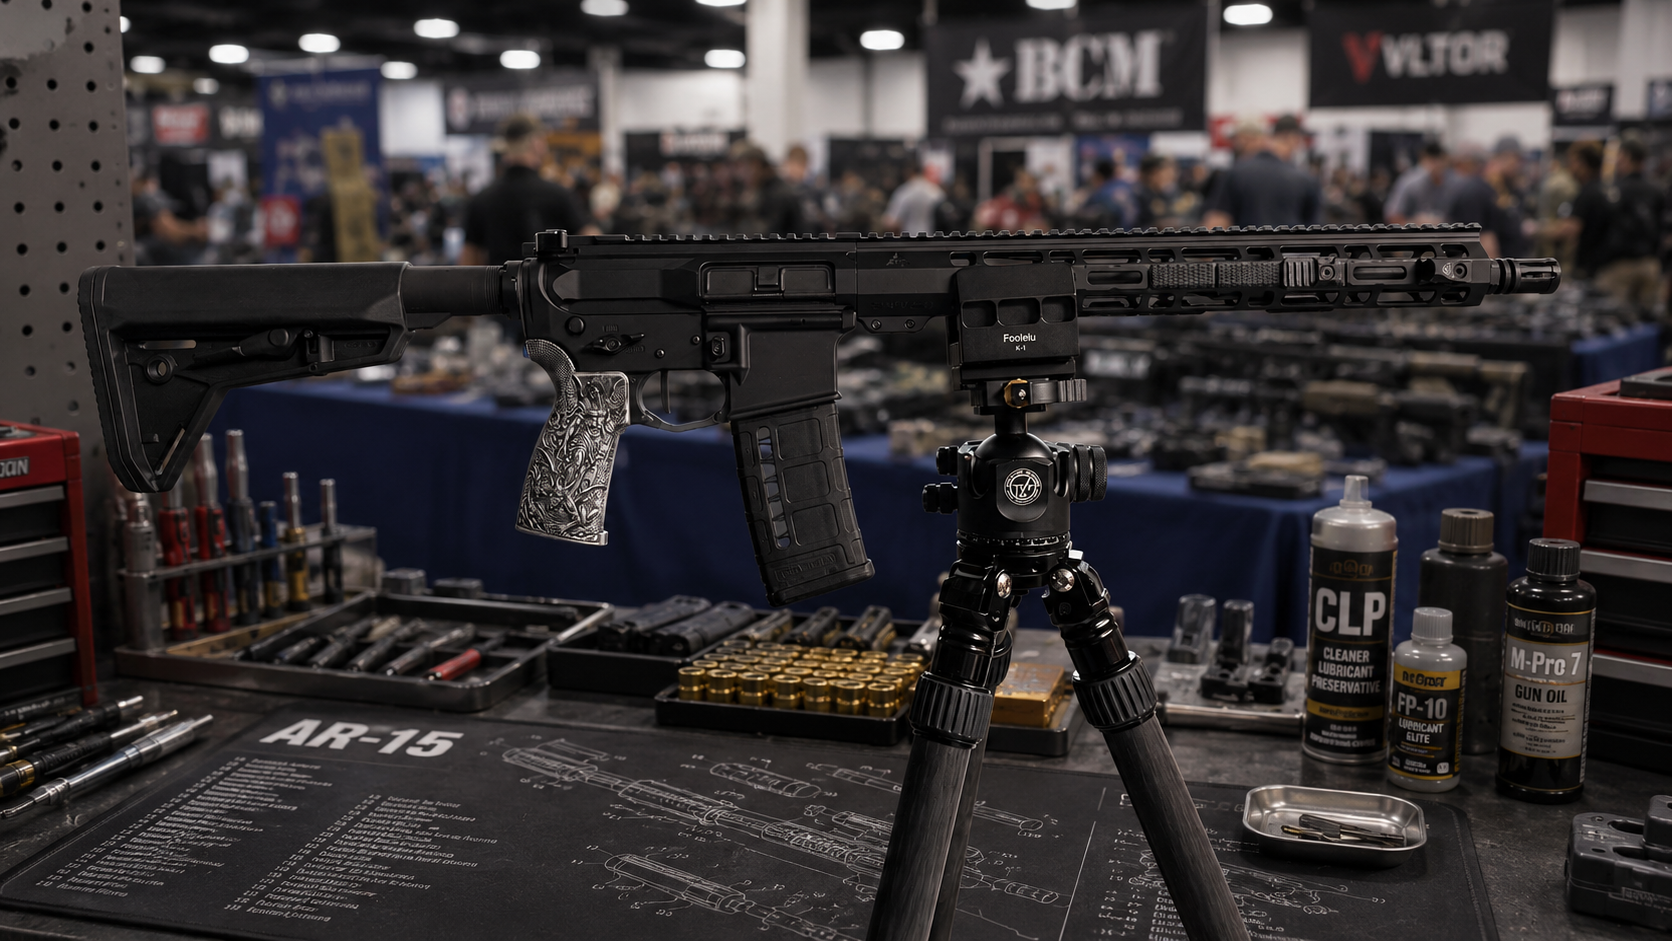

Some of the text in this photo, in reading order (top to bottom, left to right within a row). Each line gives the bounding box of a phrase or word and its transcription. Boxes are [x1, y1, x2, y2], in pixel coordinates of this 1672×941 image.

[1014, 29, 1164, 103] BCM
[1314, 586, 1387, 637] CLP
[1317, 660, 1375, 680] LUBRICANT
[1322, 646, 1371, 664] CLEANER
[1510, 645, 1583, 677] M-Pro 7
[1311, 673, 1382, 695] PRESERVATIVE
[1514, 683, 1568, 704] GUN OIL
[1397, 690, 1448, 720] FP-10
[258, 718, 465, 758] AR-15
